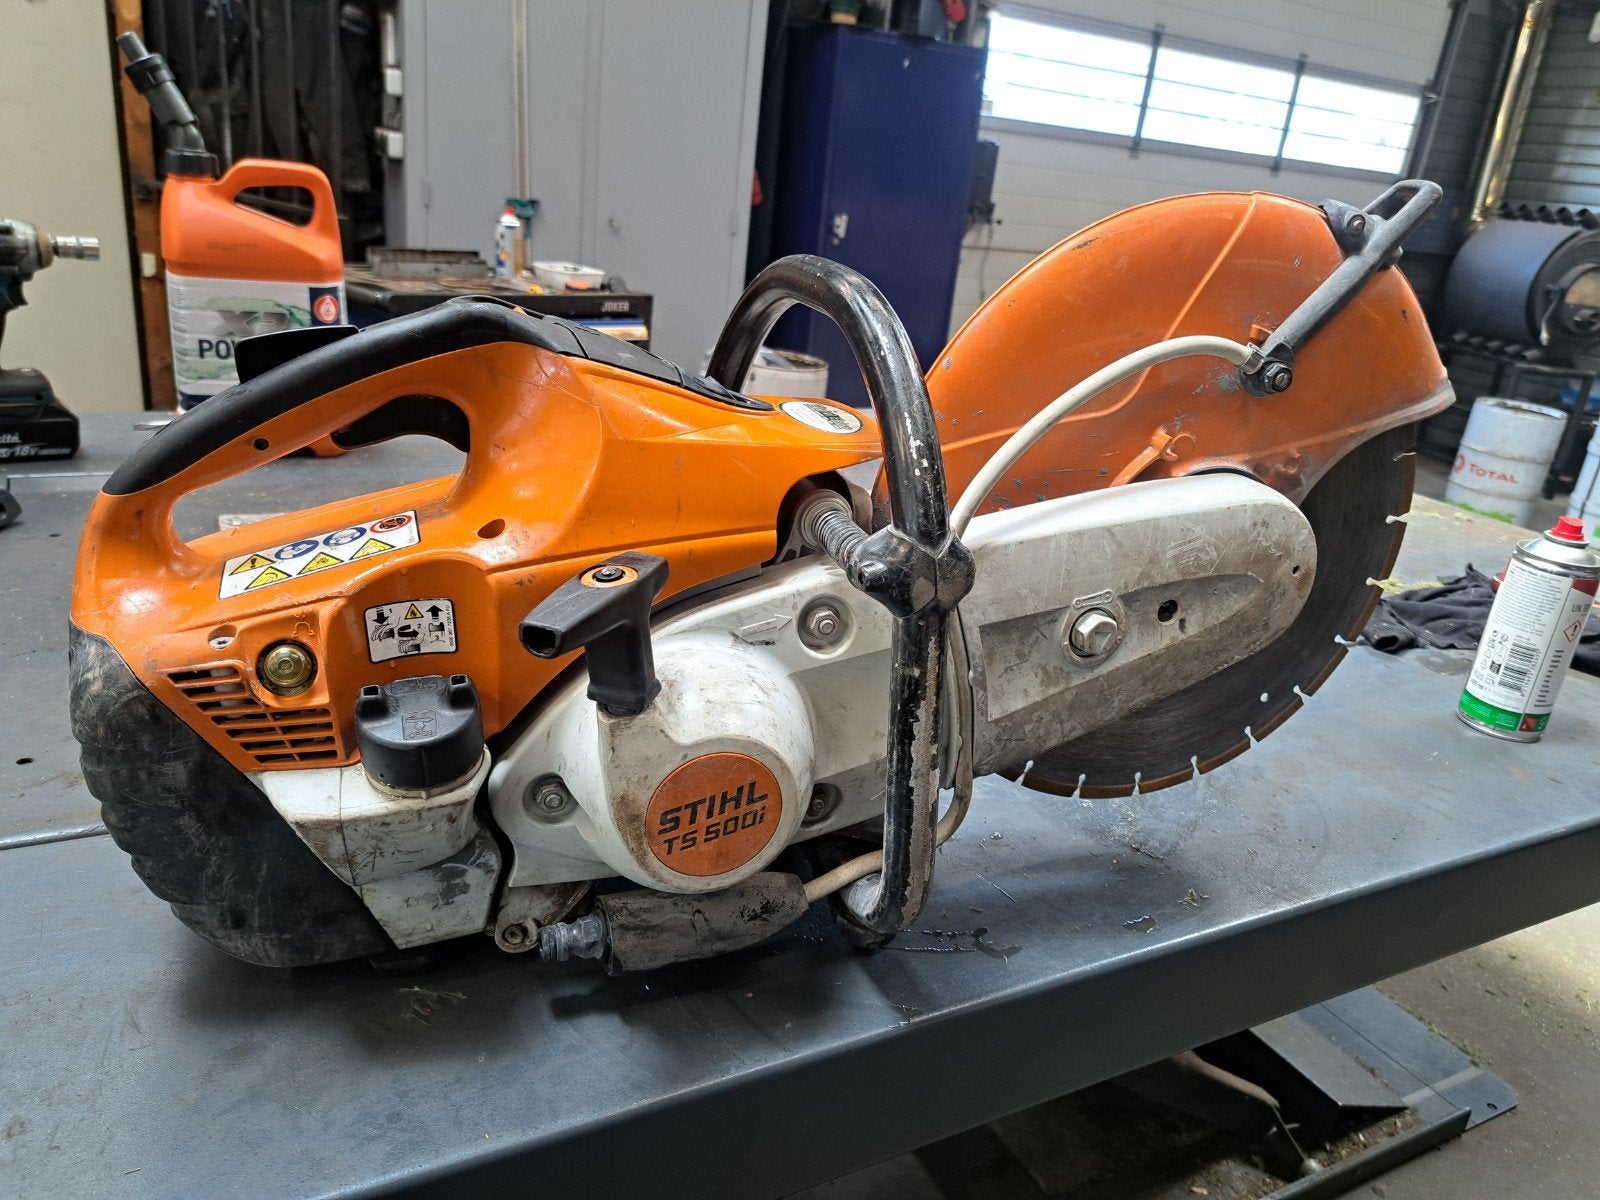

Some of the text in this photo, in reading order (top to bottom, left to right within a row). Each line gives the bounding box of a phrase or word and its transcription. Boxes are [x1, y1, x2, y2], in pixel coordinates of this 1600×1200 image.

[198, 339, 237, 360] PO
[1470, 463, 1518, 484] TOTAL
[658, 781, 769, 836] STIHL
[663, 805, 767, 856] TS 500i
